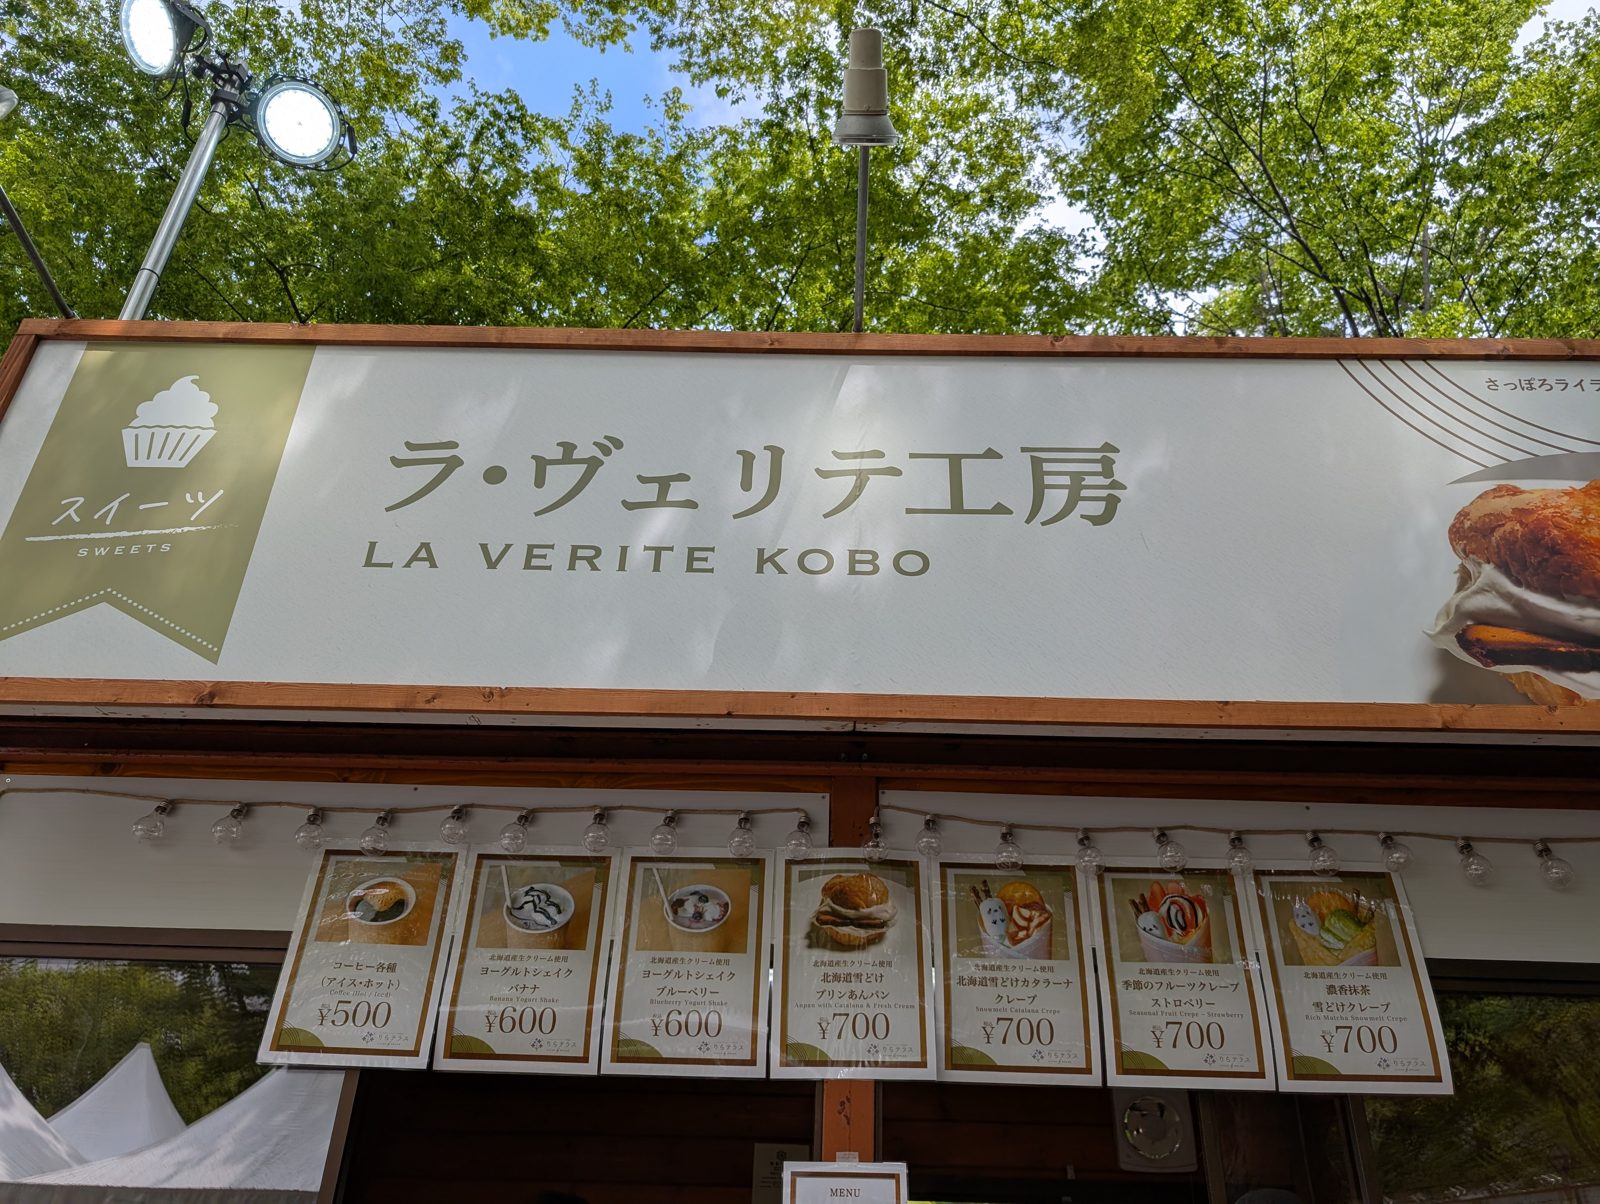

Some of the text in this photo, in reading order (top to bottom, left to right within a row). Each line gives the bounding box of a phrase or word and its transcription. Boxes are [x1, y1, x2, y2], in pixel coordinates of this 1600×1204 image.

[384, 434, 1128, 527] ラ・ヴェリテ工房
[51, 488, 225, 526] スイーツ
[76, 543, 172, 558] SWEETS
[362, 540, 931, 577] LA VERITE KOBO
[489, 954, 568, 963] 北海道産生クリーム使用
[650, 957, 730, 965] 北海道産生クリーム使用
[813, 960, 893, 968] 北海道産生クリーム使用
[333, 962, 398, 973] コーヒー各種
[480, 966, 573, 978] ヨーグルトシェイク
[1138, 968, 1220, 976] 北海道産生クリーム使用
[642, 969, 736, 981] ヨーグルトシェイク
[821, 972, 884, 983] 北海道雪どけ
[1304, 971, 1388, 980] 北海道産生クリーム使用
[957, 976, 1073, 989] 北海道雪どけカタラーナ
[1122, 980, 1240, 992] 季節のフルーツクレープ
[508, 984, 540, 994] バナナ
[656, 987, 719, 998] ブルーベリー
[816, 990, 890, 1000] プリンあんパン
[995, 994, 1038, 1005] クレープ
[1151, 998, 1216, 1009] ストロベリー
[1312, 1002, 1391, 1013] 雪どけクレープ
[318, 1000, 392, 1029] ¥500
[485, 1006, 557, 1034] ¥600
[651, 1009, 723, 1037] ¥600
[817, 1012, 890, 1040] ¥700
[981, 1017, 1054, 1045] ¥700
[1150, 1021, 1225, 1050] ¥700
[1320, 1025, 1398, 1054] ¥700
[830, 1188, 861, 1198] MENU
